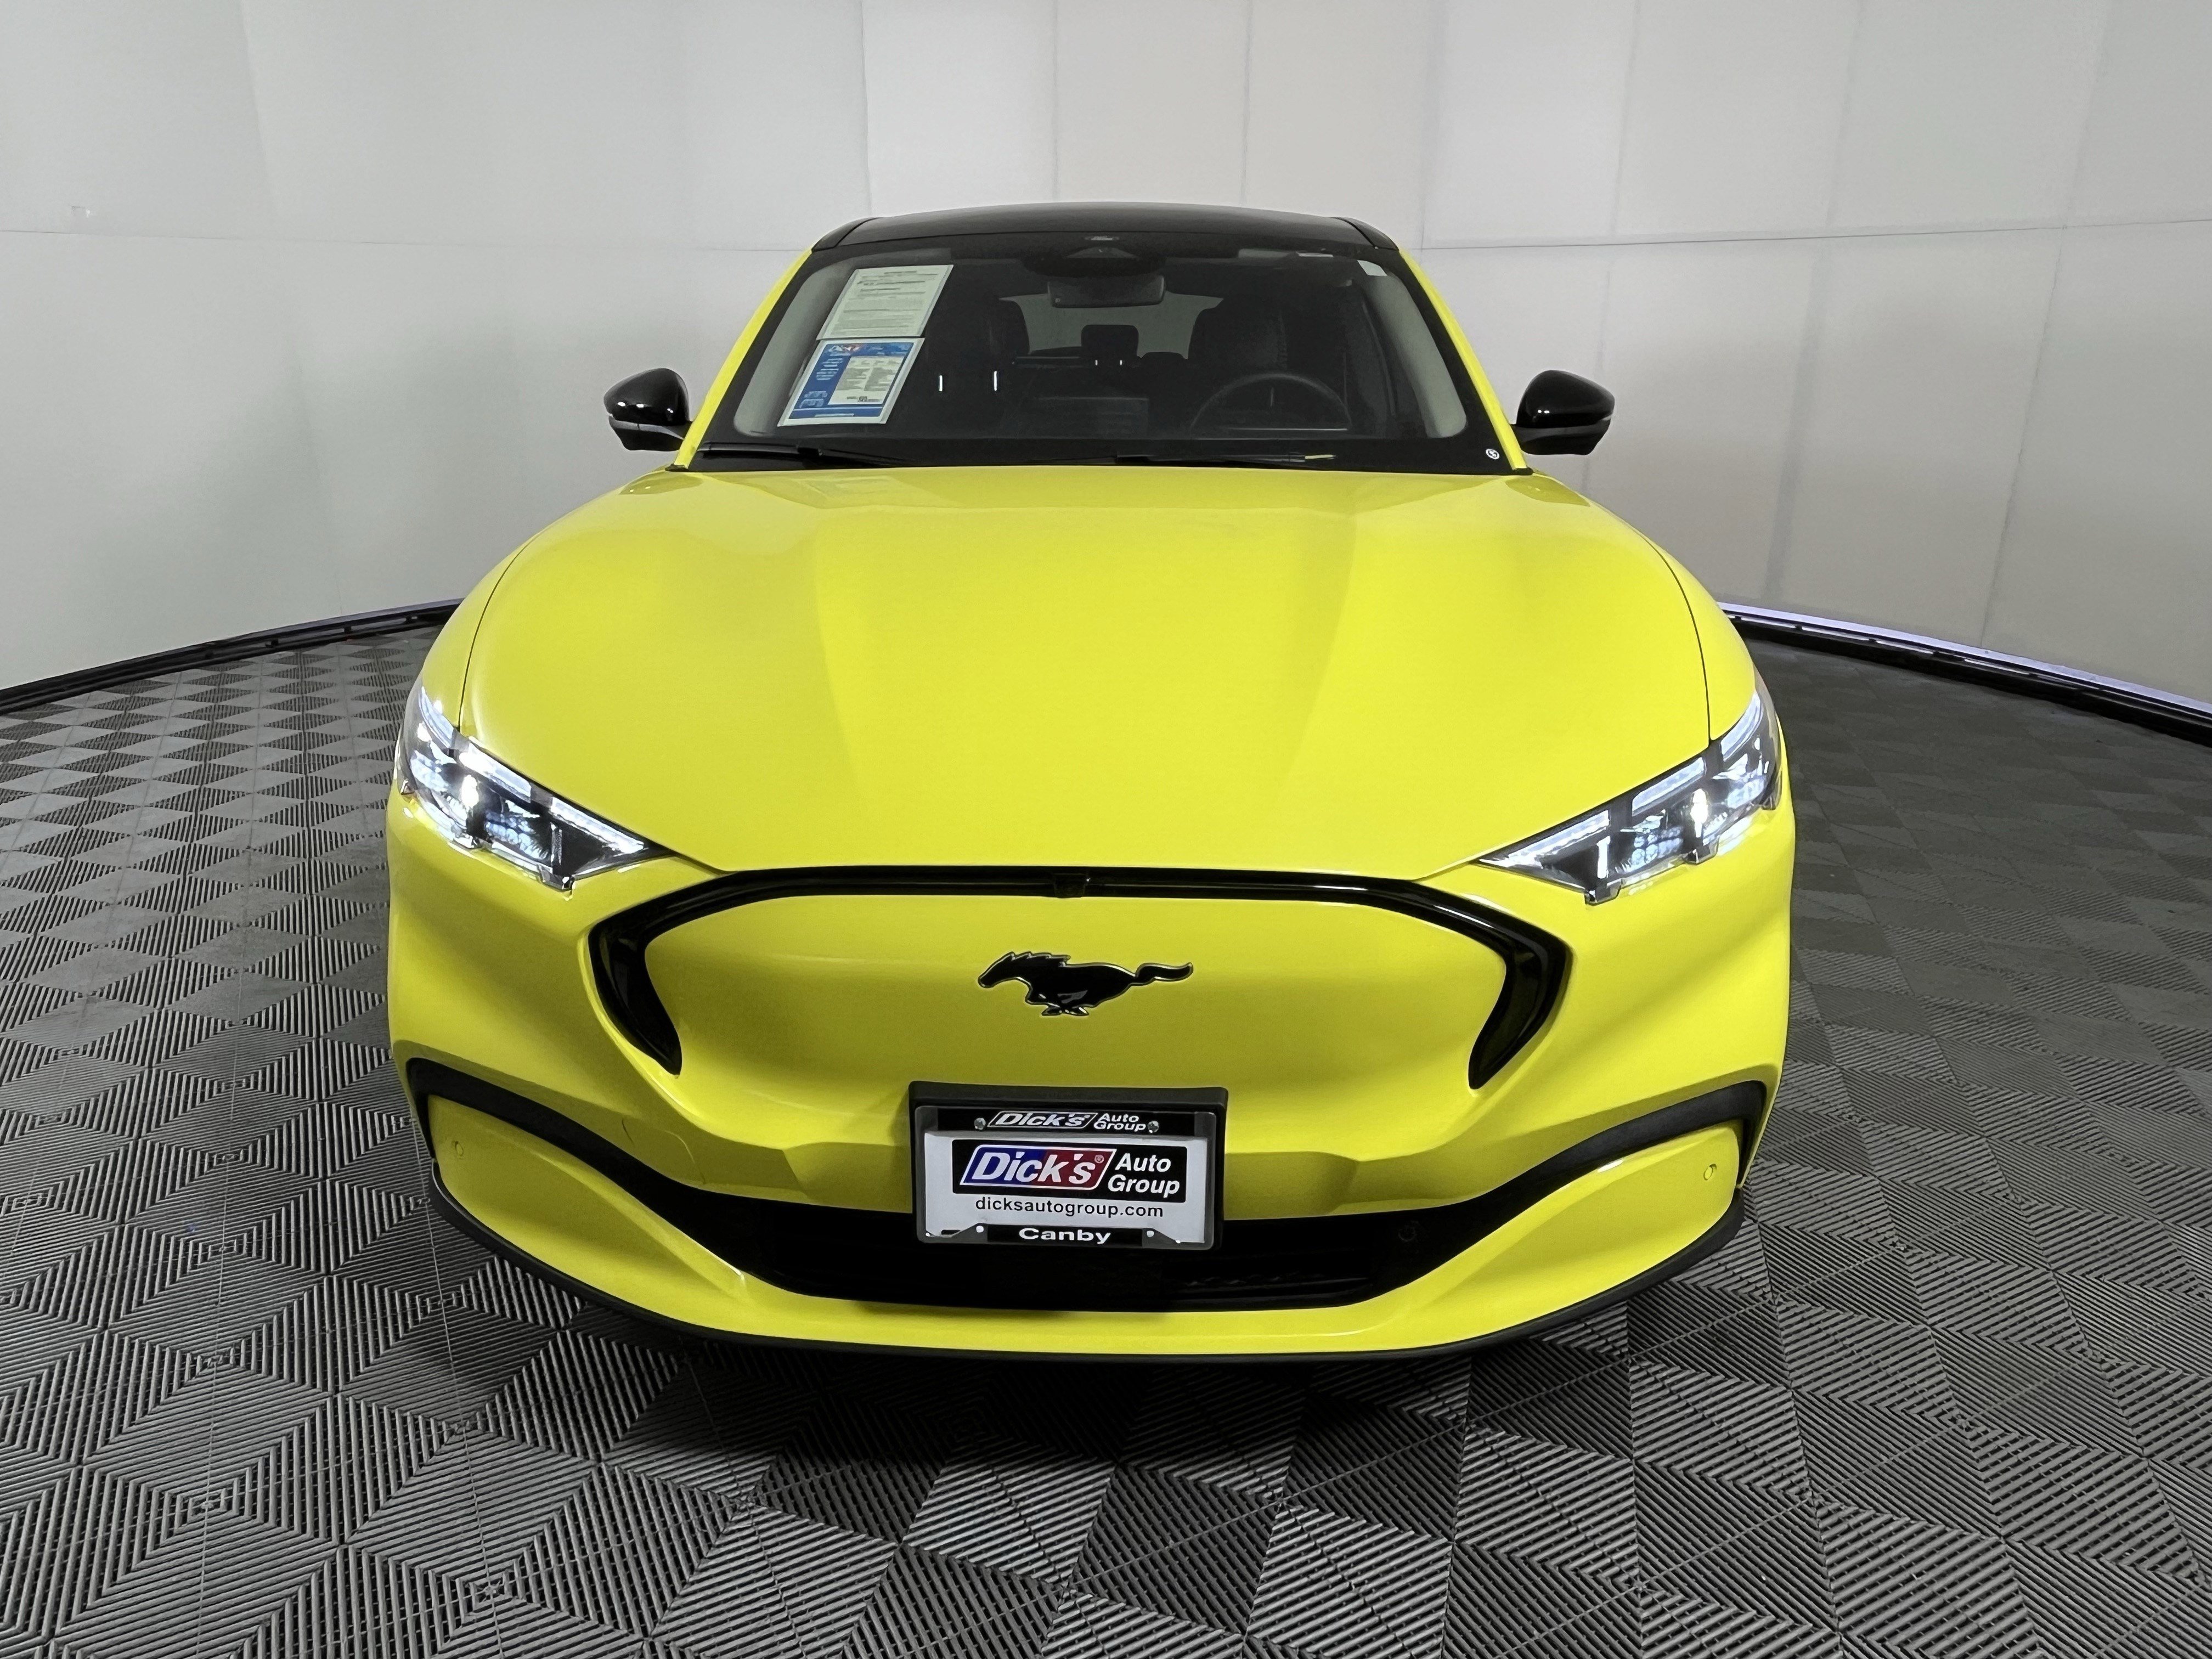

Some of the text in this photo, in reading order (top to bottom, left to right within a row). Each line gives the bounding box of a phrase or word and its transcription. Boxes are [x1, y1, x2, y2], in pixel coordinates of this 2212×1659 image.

[995, 1113, 1086, 1126] Dick's
[1097, 1113, 1139, 1122] Auto
[1093, 1121, 1146, 1132] Group
[972, 1152, 1096, 1184] Dick's
[1115, 1153, 1171, 1172] Auto
[1108, 1174, 1180, 1198] Group
[975, 1197, 1164, 1217] dicksautogroup.com
[1019, 1228, 1111, 1244] Canby
